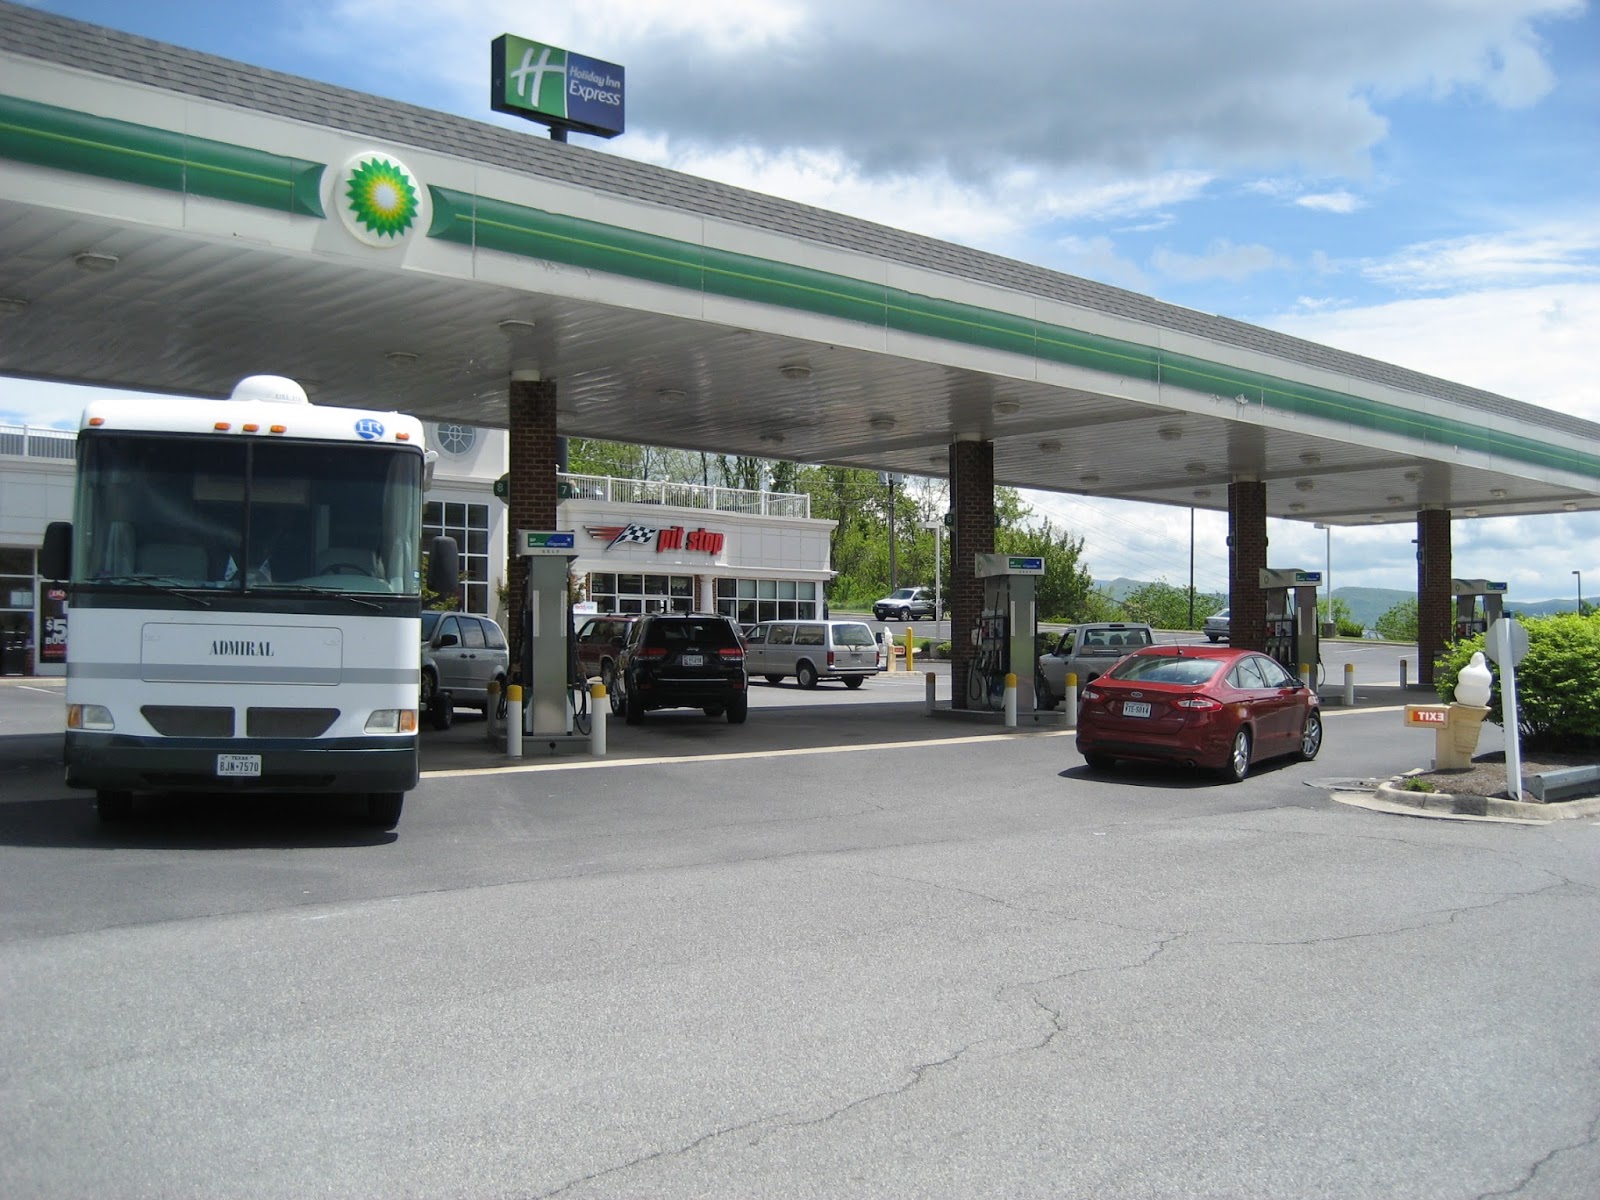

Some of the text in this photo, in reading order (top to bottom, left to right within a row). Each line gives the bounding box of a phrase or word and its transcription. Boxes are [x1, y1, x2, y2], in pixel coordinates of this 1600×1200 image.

[570, 66, 621, 88] Holiday Inn
[570, 80, 621, 105] Express
[497, 483, 504, 493] 8
[561, 485, 568, 495] 7
[657, 526, 724, 556] pit stop
[45, 636, 67, 645] BUC
[209, 640, 274, 656] ADMIRAL
